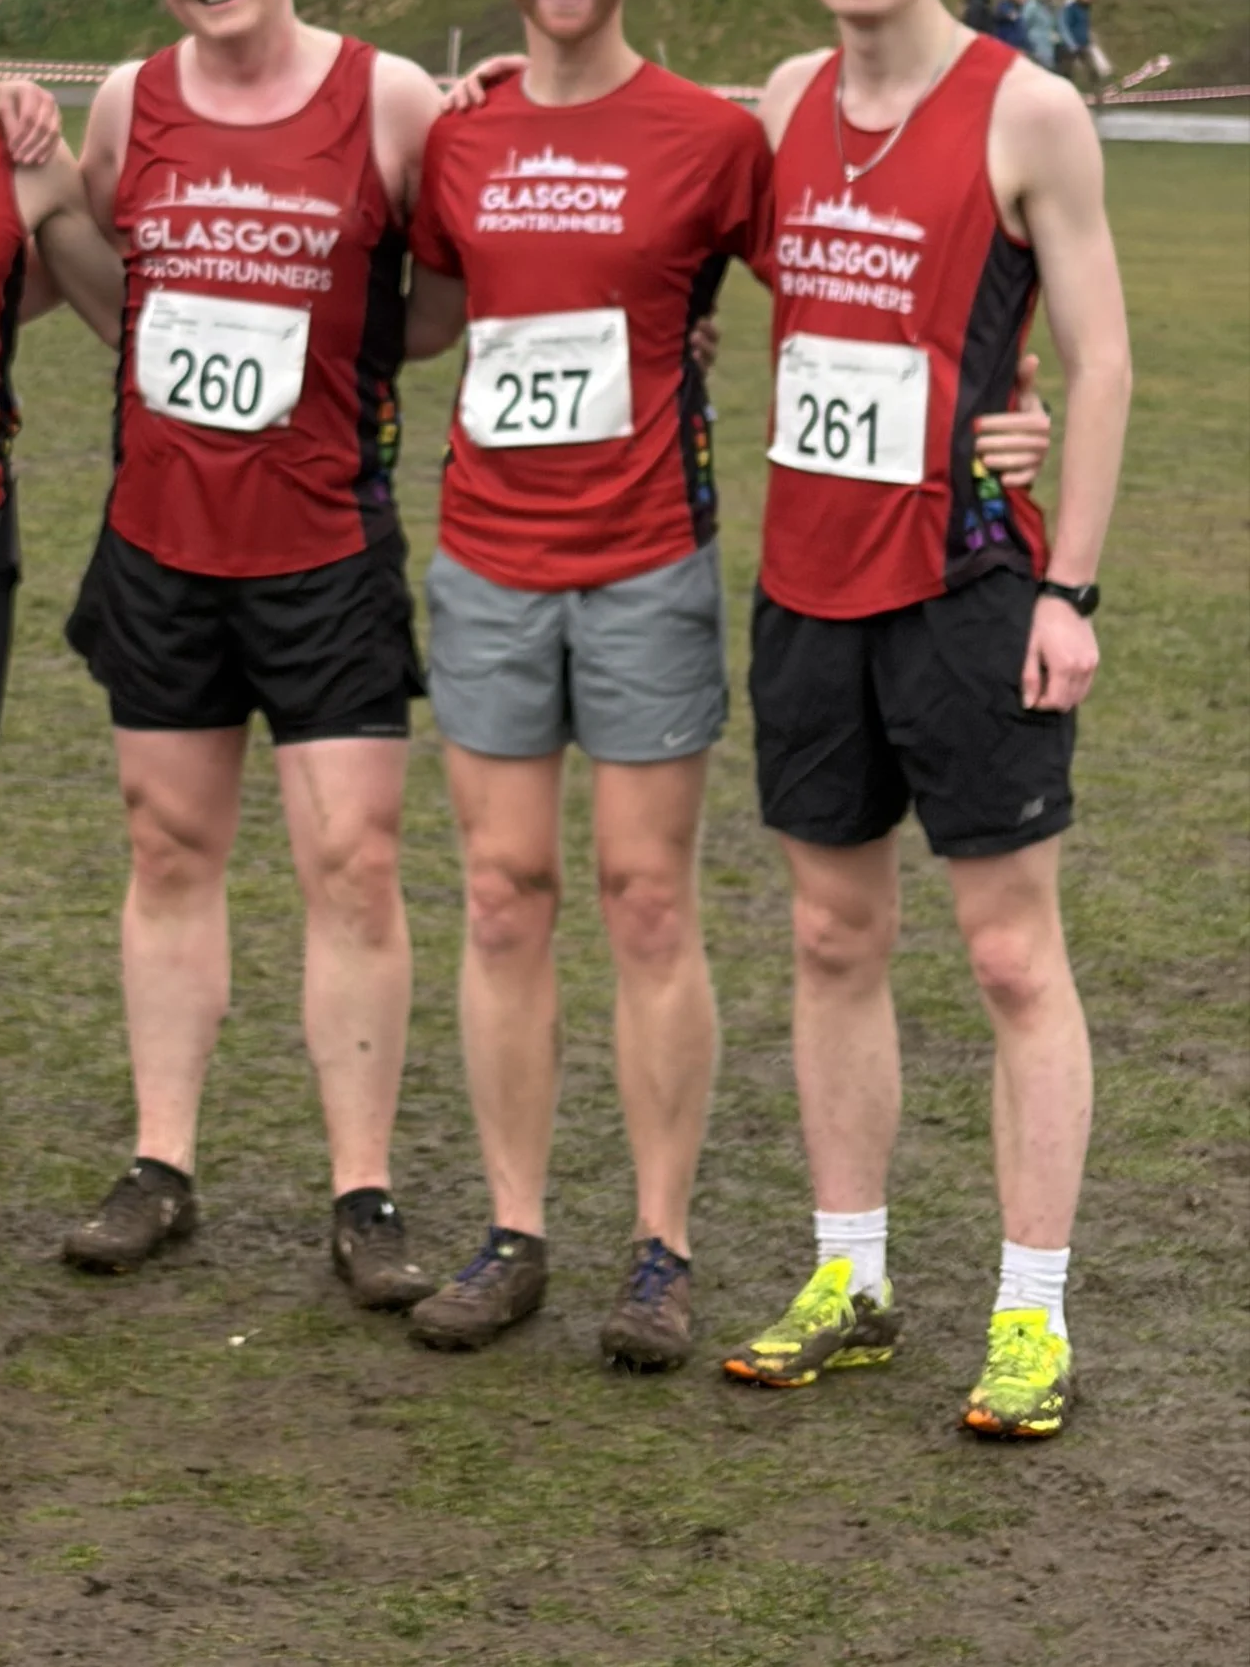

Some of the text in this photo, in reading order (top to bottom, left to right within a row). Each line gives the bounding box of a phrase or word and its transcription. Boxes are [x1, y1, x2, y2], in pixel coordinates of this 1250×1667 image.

[480, 183, 627, 211] GLASGOW
[137, 218, 340, 258] GLASGOW
[476, 212, 624, 234] FRONTRUNNERS
[778, 235, 920, 281] GLASGOW
[167, 347, 263, 417] 260
[493, 369, 592, 433] 257
[797, 393, 879, 465] 261
